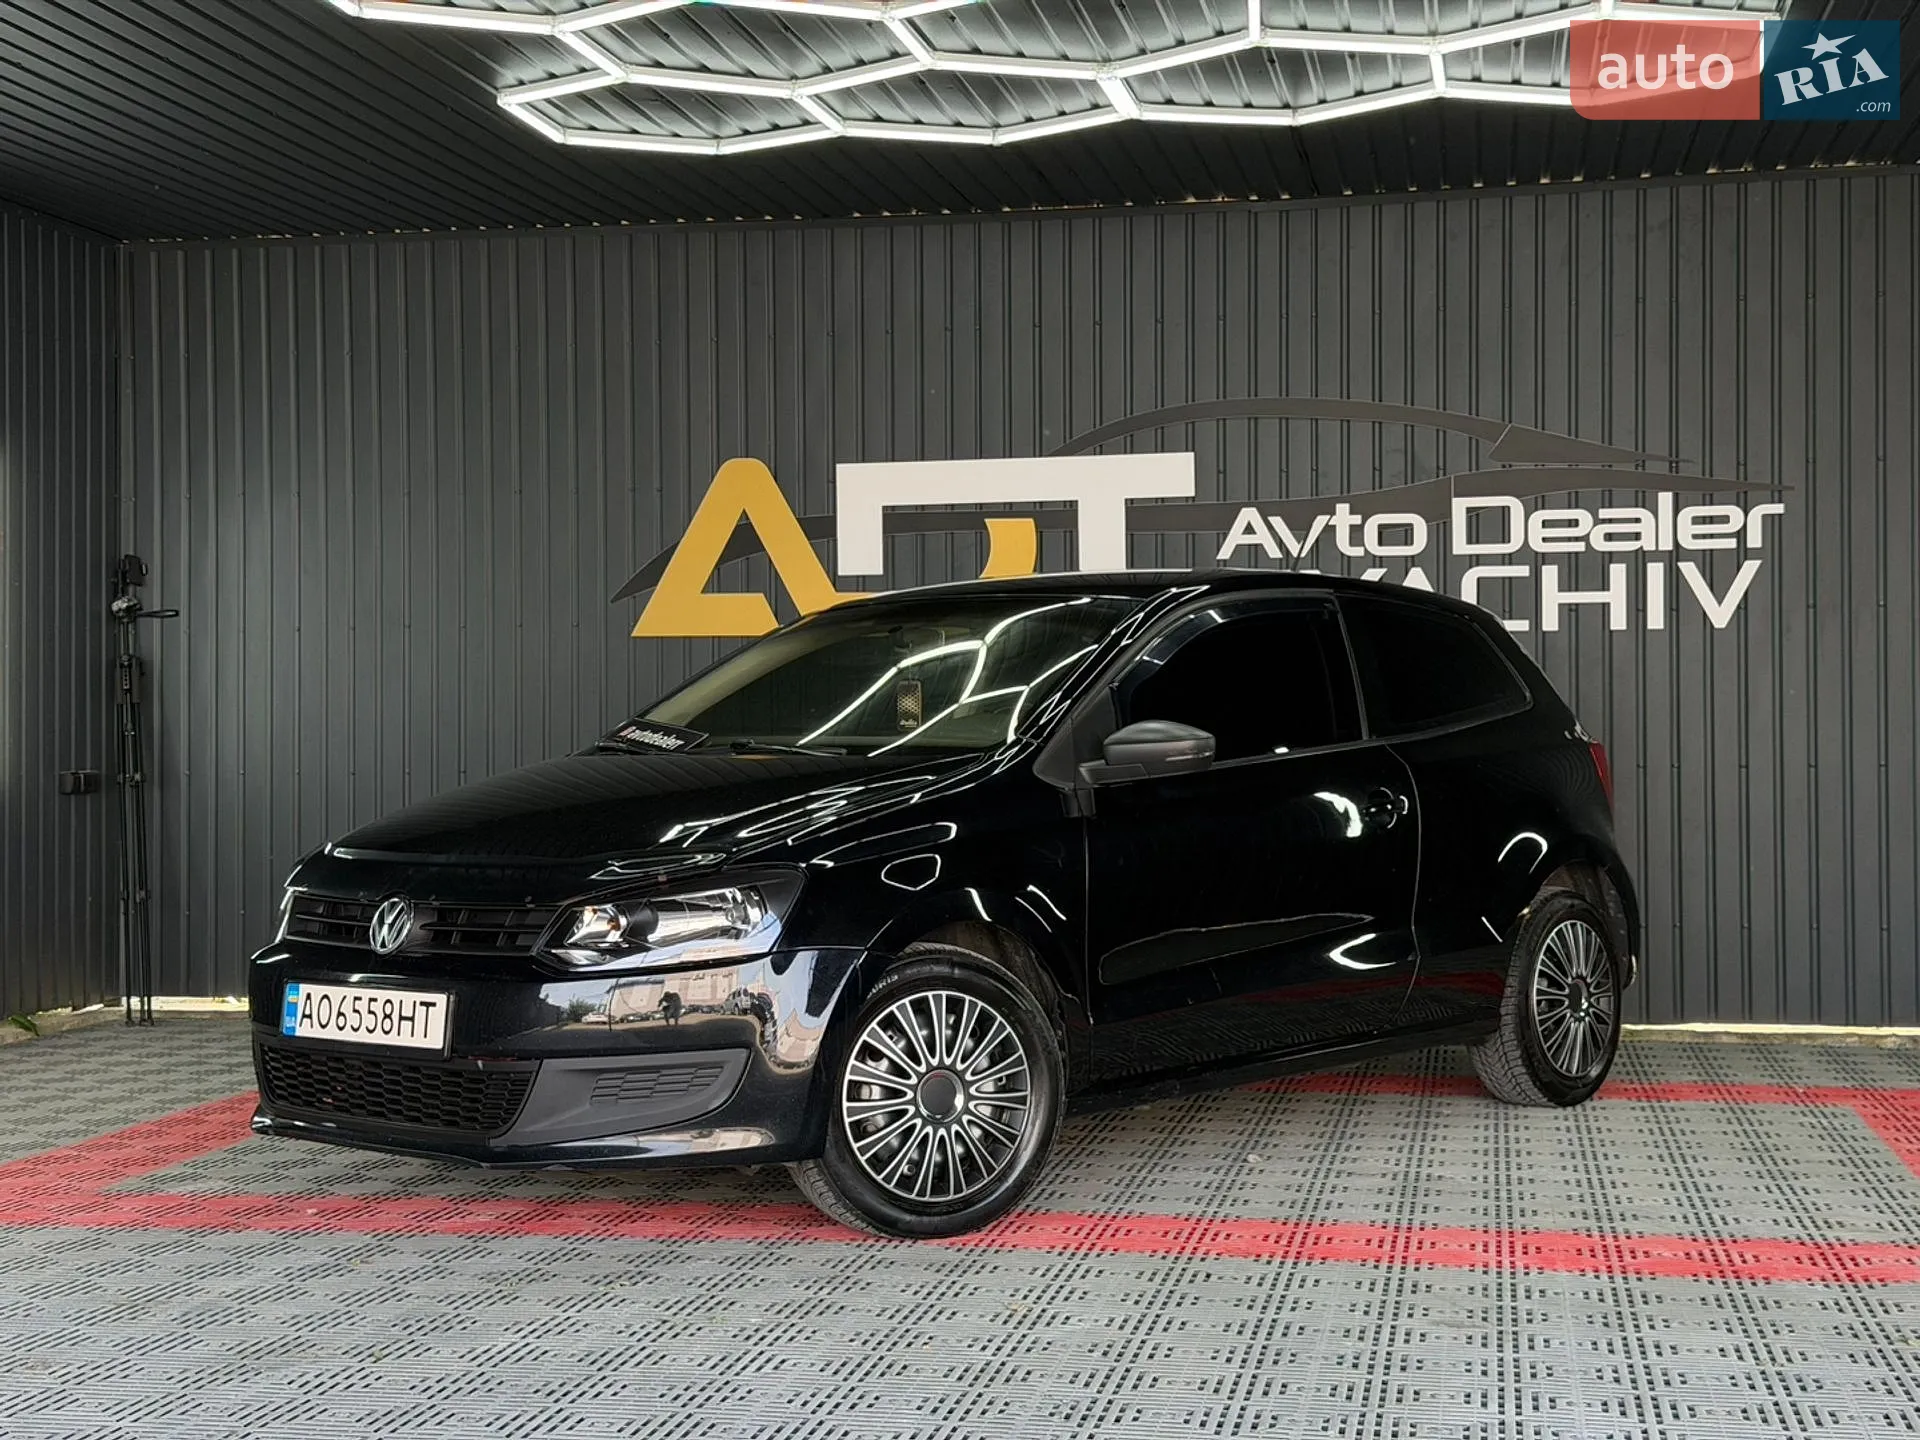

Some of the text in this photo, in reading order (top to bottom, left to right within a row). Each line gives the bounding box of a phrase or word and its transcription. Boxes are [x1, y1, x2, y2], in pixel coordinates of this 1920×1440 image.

[1216, 492, 1785, 560] Avto Dealer
[299, 991, 438, 1040] AO6558HT
